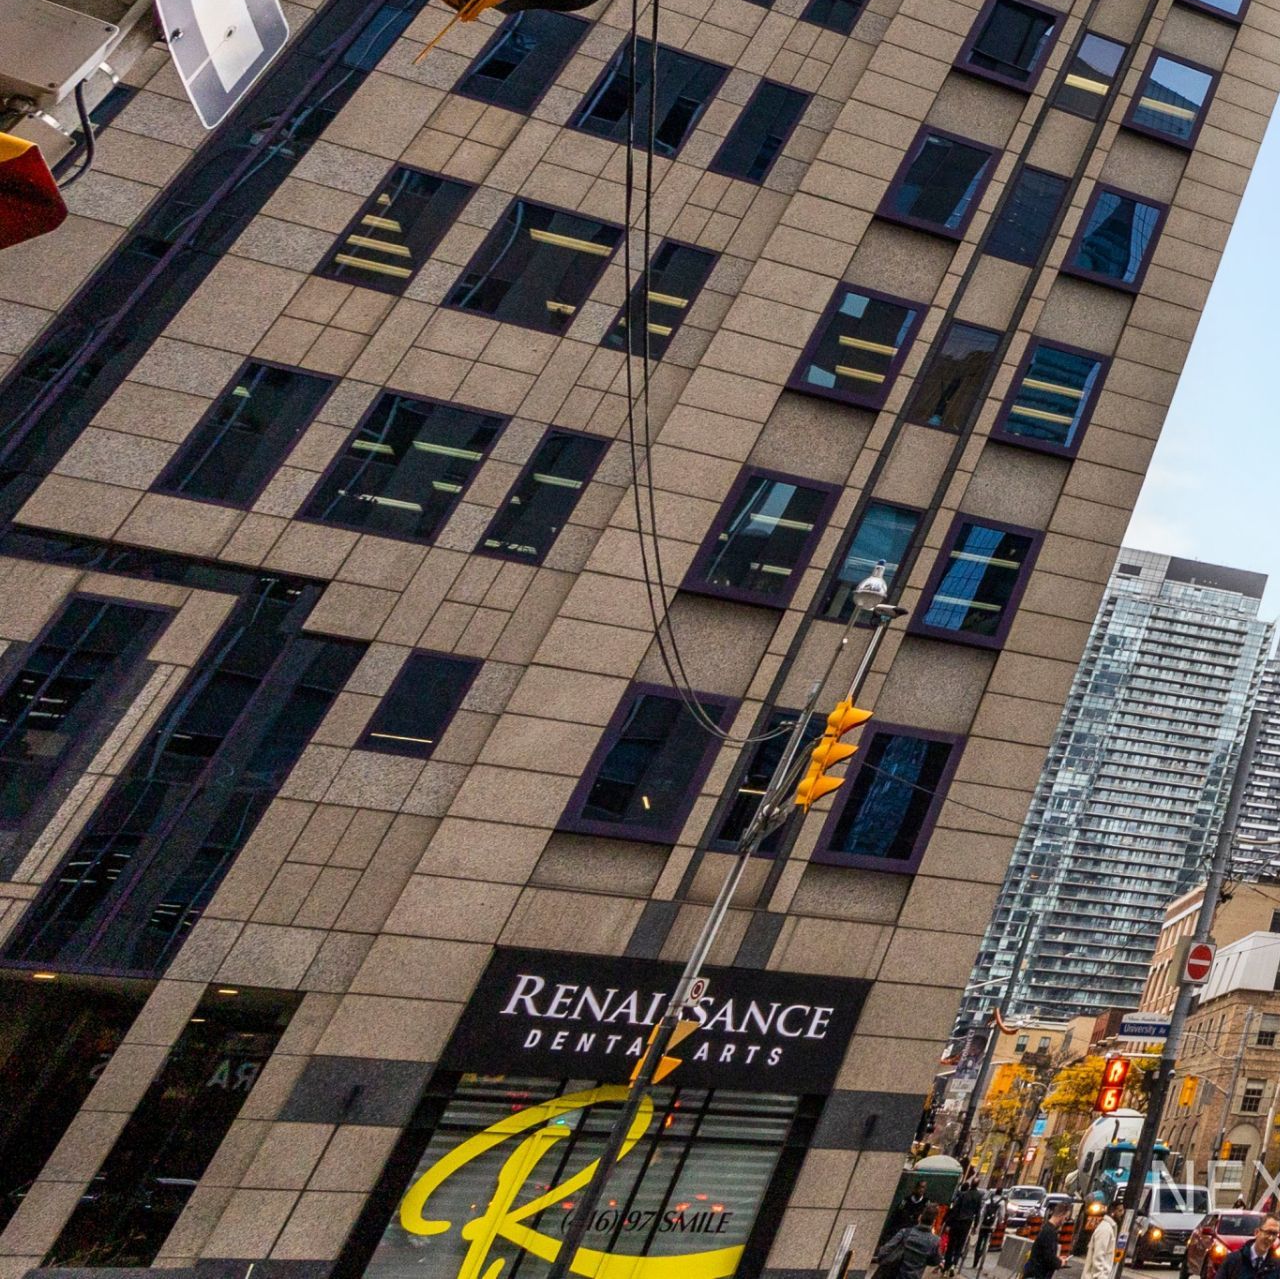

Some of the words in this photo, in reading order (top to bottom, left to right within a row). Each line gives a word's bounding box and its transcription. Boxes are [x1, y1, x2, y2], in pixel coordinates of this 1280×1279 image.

[499, 974, 835, 1040] RENAISANCE
[1123, 1023, 1157, 1036] University
[523, 1029, 645, 1056] DENTA
[693, 1041, 784, 1066] ARTS
[1103, 1089, 1117, 1110] 6
[560, 1209, 619, 1234] (16)
[658, 1210, 734, 1234] SMILE
